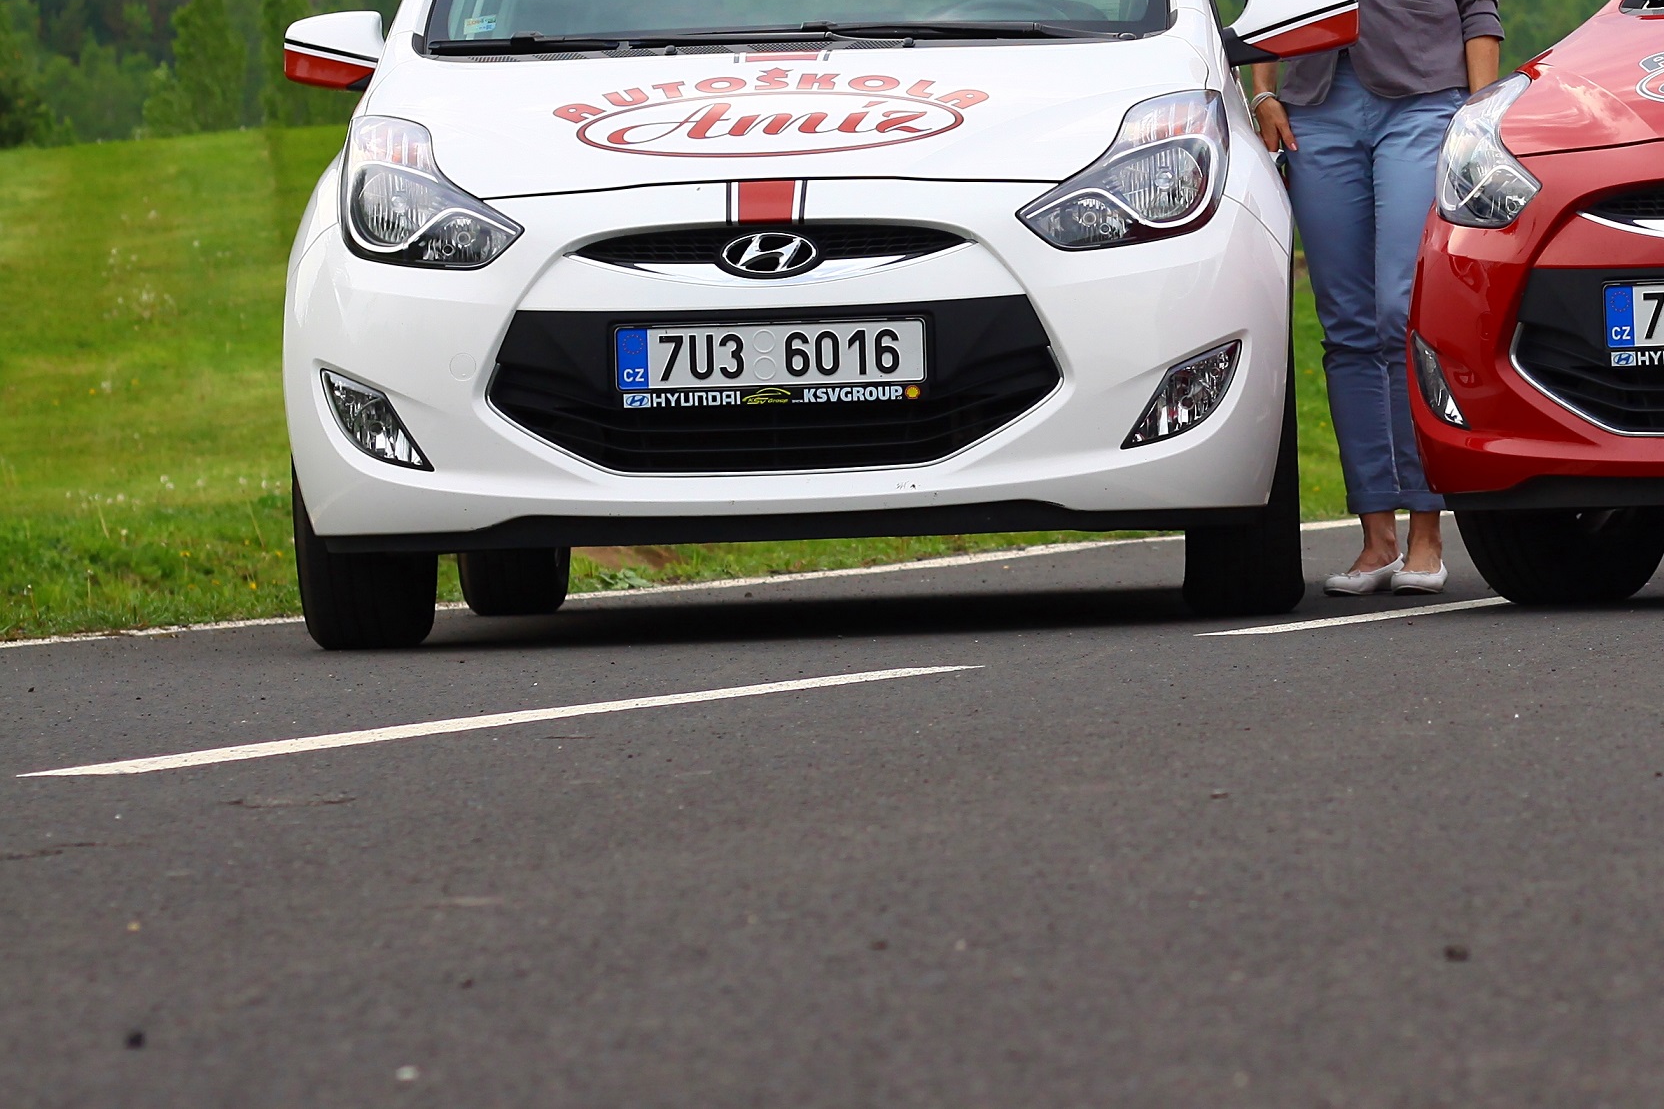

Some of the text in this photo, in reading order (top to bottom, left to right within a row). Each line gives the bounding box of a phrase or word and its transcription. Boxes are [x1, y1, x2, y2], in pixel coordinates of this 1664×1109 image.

[552, 67, 990, 124] AUTOŠKOLA
[1611, 326, 1632, 340] CZ
[658, 328, 901, 382] 7U3 6016
[623, 368, 645, 382] CZ
[652, 391, 741, 407] HYUNDAI
